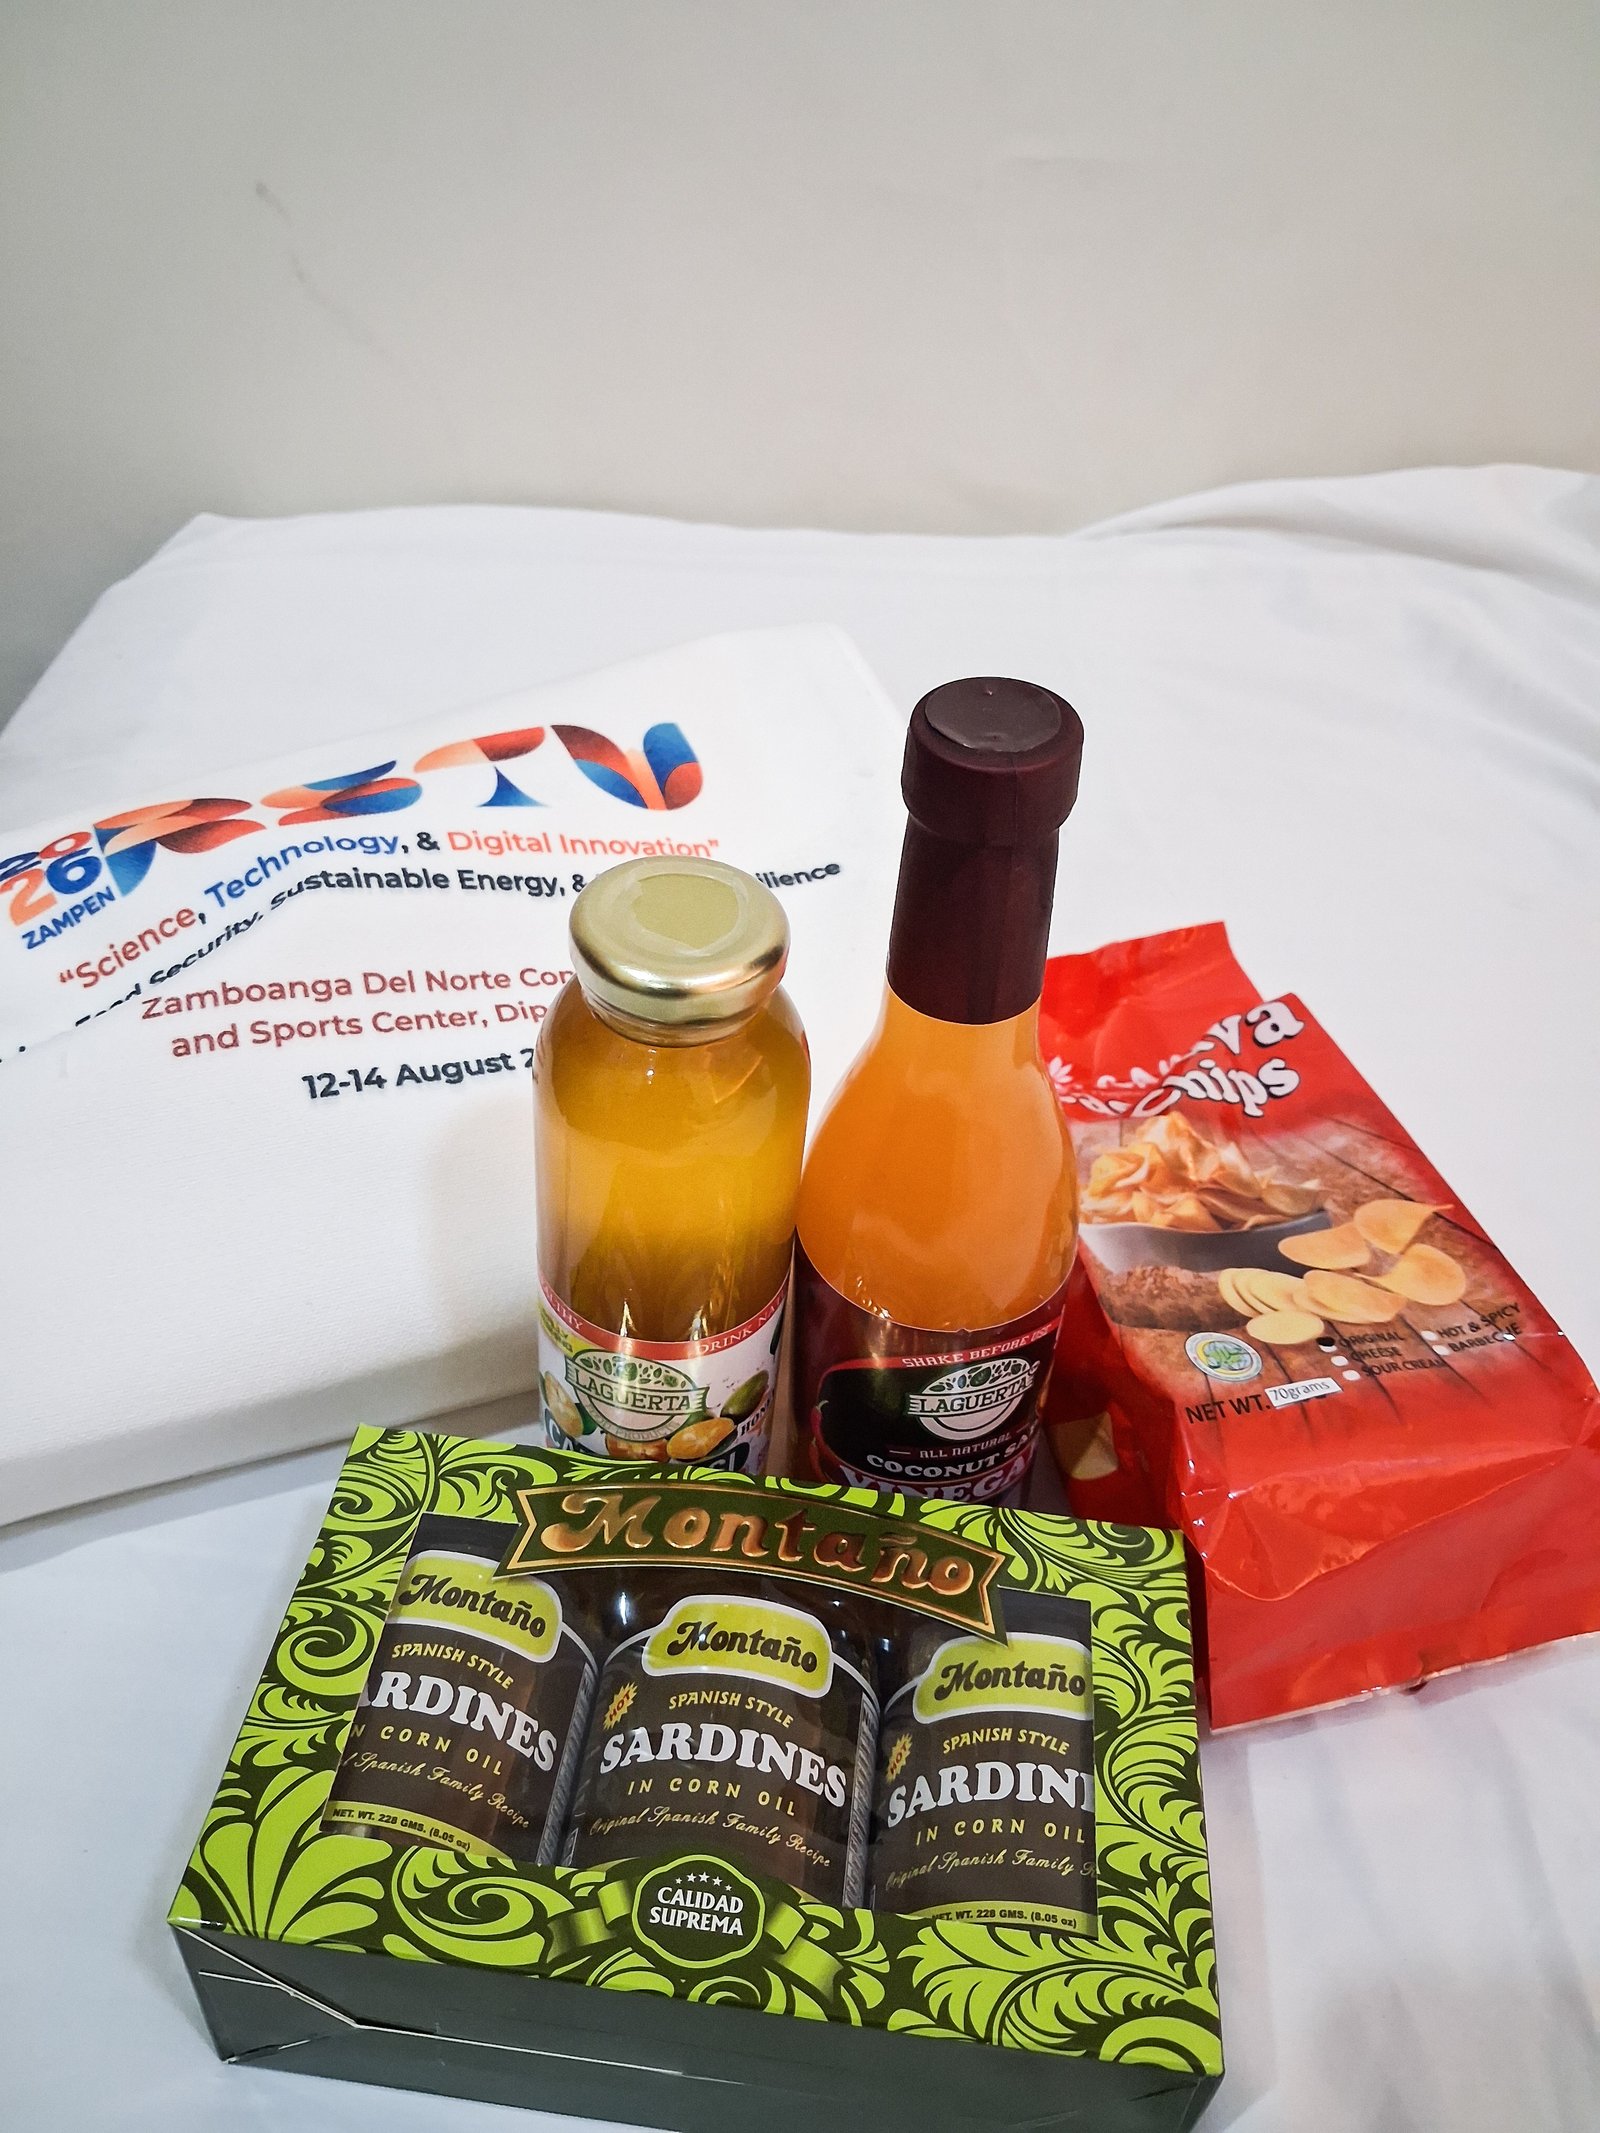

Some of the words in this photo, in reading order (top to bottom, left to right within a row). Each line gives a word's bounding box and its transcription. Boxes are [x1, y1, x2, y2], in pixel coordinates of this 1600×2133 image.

[0, 847, 102, 927] 26
[204, 835, 409, 908] Technology,
[416, 831, 440, 851] &
[447, 830, 552, 857] Digital
[457, 869, 565, 897] Energy,
[21, 886, 116, 950] ZAMPEN
[141, 975, 352, 1021] Zamboanga
[362, 970, 416, 995] Del
[425, 970, 511, 993] Norte
[172, 1023, 240, 1057] and
[250, 1014, 363, 1047] Sports
[371, 1007, 488, 1033] Center,
[302, 1066, 387, 1099] 12-14
[395, 1051, 516, 1086] August
[1339, 1331, 1404, 1348] ORIGINAL
[1438, 1325, 1466, 1338] HOT
[1469, 1321, 1481, 1333] &
[1481, 1303, 1520, 1325] SPICY
[1448, 1323, 1523, 1352] BARBECE
[902, 1353, 964, 1368] SHAKE
[970, 1335, 1030, 1360] BEFORE
[1351, 1346, 1401, 1362] CHEESE
[1362, 1361, 1401, 1377] SOUR
[575, 1369, 692, 1411] LAGUERTA
[920, 1378, 1028, 1414] LAGUERTA
[1185, 1400, 1224, 1424] NET
[1228, 1393, 1270, 1416] WT.
[1269, 1380, 1331, 1401] 70grams
[866, 1452, 1001, 1479] COCONUT
[919, 1450, 947, 1459] ALL
[952, 1432, 1012, 1456] NATURAL
[540, 1493, 975, 1595] Montaño
[398, 1573, 547, 1638] Montaño
[392, 1643, 466, 1665] SPANISH
[470, 1654, 515, 1690] STYLE
[666, 1620, 818, 1673] Montaño
[934, 1660, 1086, 1702] Montaño
[358, 1670, 558, 1773] RDINES
[608, 1690, 634, 1722] HOT
[668, 1690, 742, 1710] SPANISH
[745, 1696, 794, 1728] STYLE
[379, 1724, 452, 1753] CORN
[465, 1749, 502, 1776] OIL
[943, 1727, 1012, 1755] SPANISH
[1017, 1729, 1070, 1755] STYLE
[600, 1722, 848, 1808] SARDINES
[354, 1751, 422, 1777] Spanish
[427, 1766, 484, 1801] Family
[487, 1791, 530, 1829] Recipe
[627, 1778, 654, 1796] IN
[669, 1777, 741, 1799] CORN
[758, 1791, 796, 1817] OIL
[332, 1807, 355, 1818] NET.
[357, 1810, 376, 1821] WT.
[378, 1813, 398, 1825] 228
[400, 1817, 427, 1834] GMS.
[429, 1826, 455, 1847] (8.05
[455, 1838, 471, 1853] oz)
[589, 1807, 650, 1837] Original
[647, 1805, 716, 1826] Spanish
[722, 1813, 782, 1845] Family
[785, 1833, 831, 1867] Recipe
[915, 1825, 938, 1847] IN
[954, 1819, 1025, 1837] CORN
[1044, 1822, 1085, 1844] OIL
[885, 1858, 932, 1891] Original
[937, 1848, 1005, 1874] Spanish
[1011, 1849, 1075, 1876] Family
[657, 1886, 744, 1914] CALIDAD
[955, 1910, 973, 1920] WT.
[976, 1908, 996, 1918] 228
[999, 1909, 1028, 1920] GMS.
[1030, 1911, 1058, 1924] (8.05
[1061, 1917, 1077, 1930] oz)
[649, 1906, 744, 1936] SUPREMA
